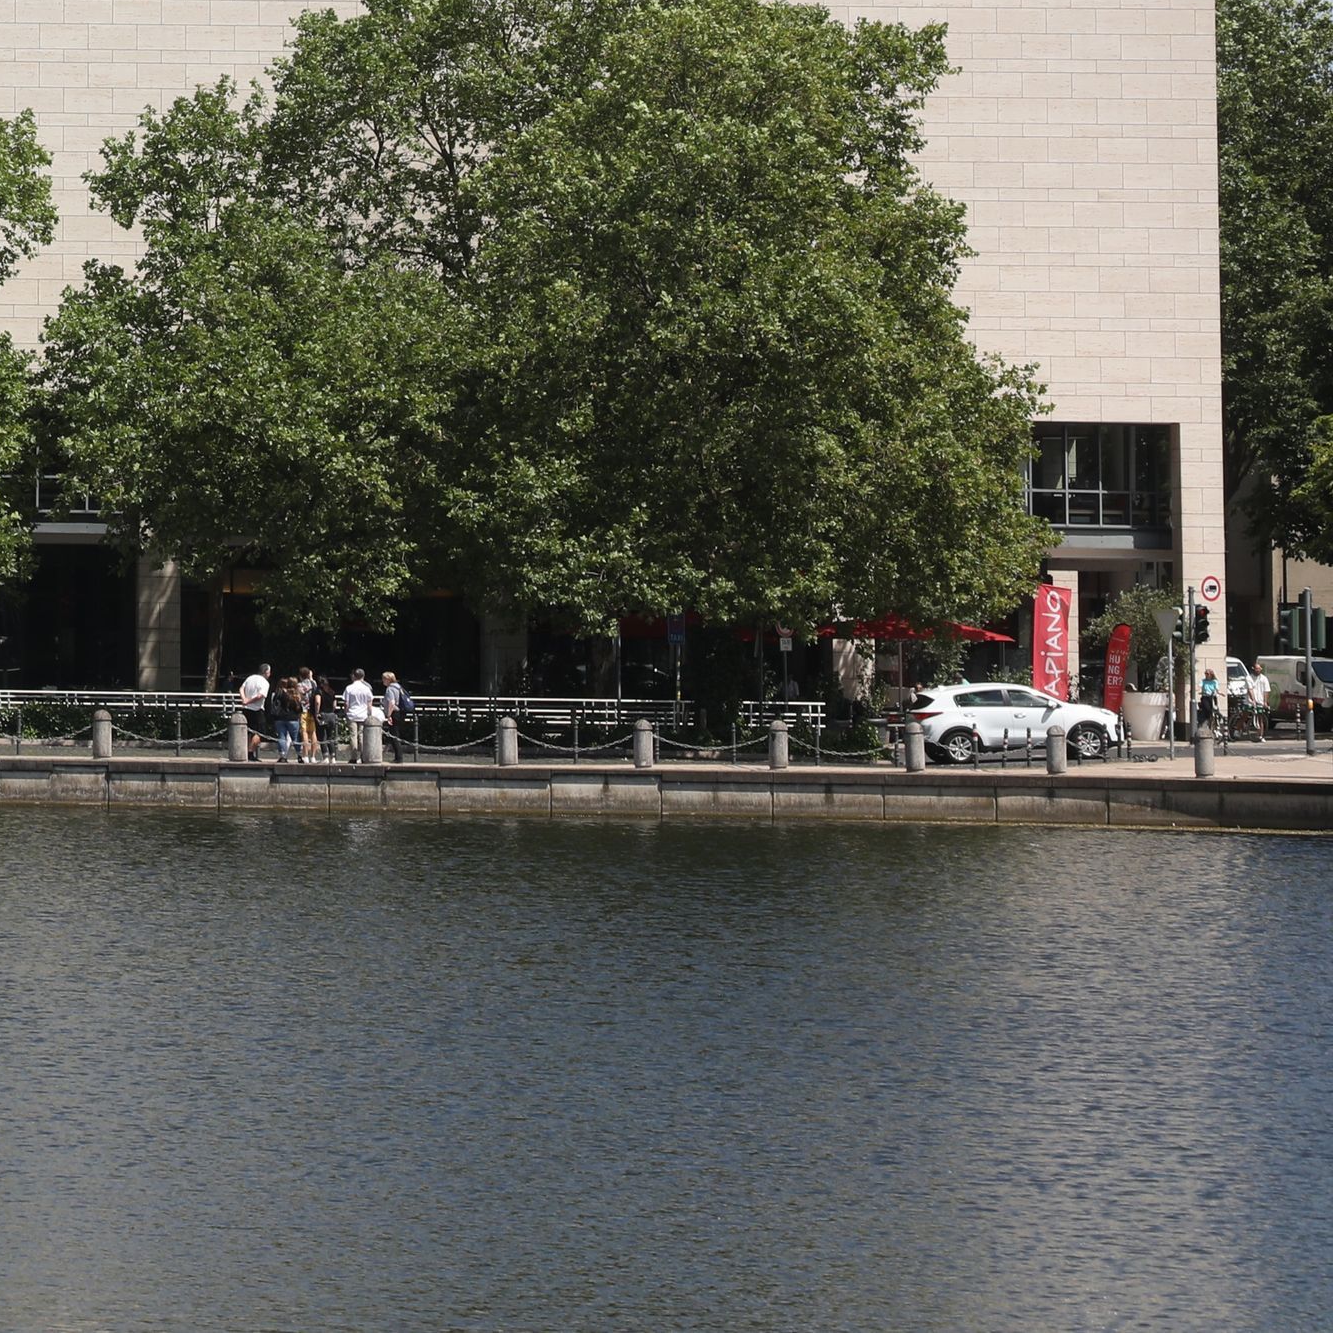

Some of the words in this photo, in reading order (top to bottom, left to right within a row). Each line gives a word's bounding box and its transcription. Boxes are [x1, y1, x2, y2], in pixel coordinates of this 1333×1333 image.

[1109, 653, 1121, 664] HU
[1108, 665, 1121, 675] NG
[1107, 675, 1124, 686] ER?
